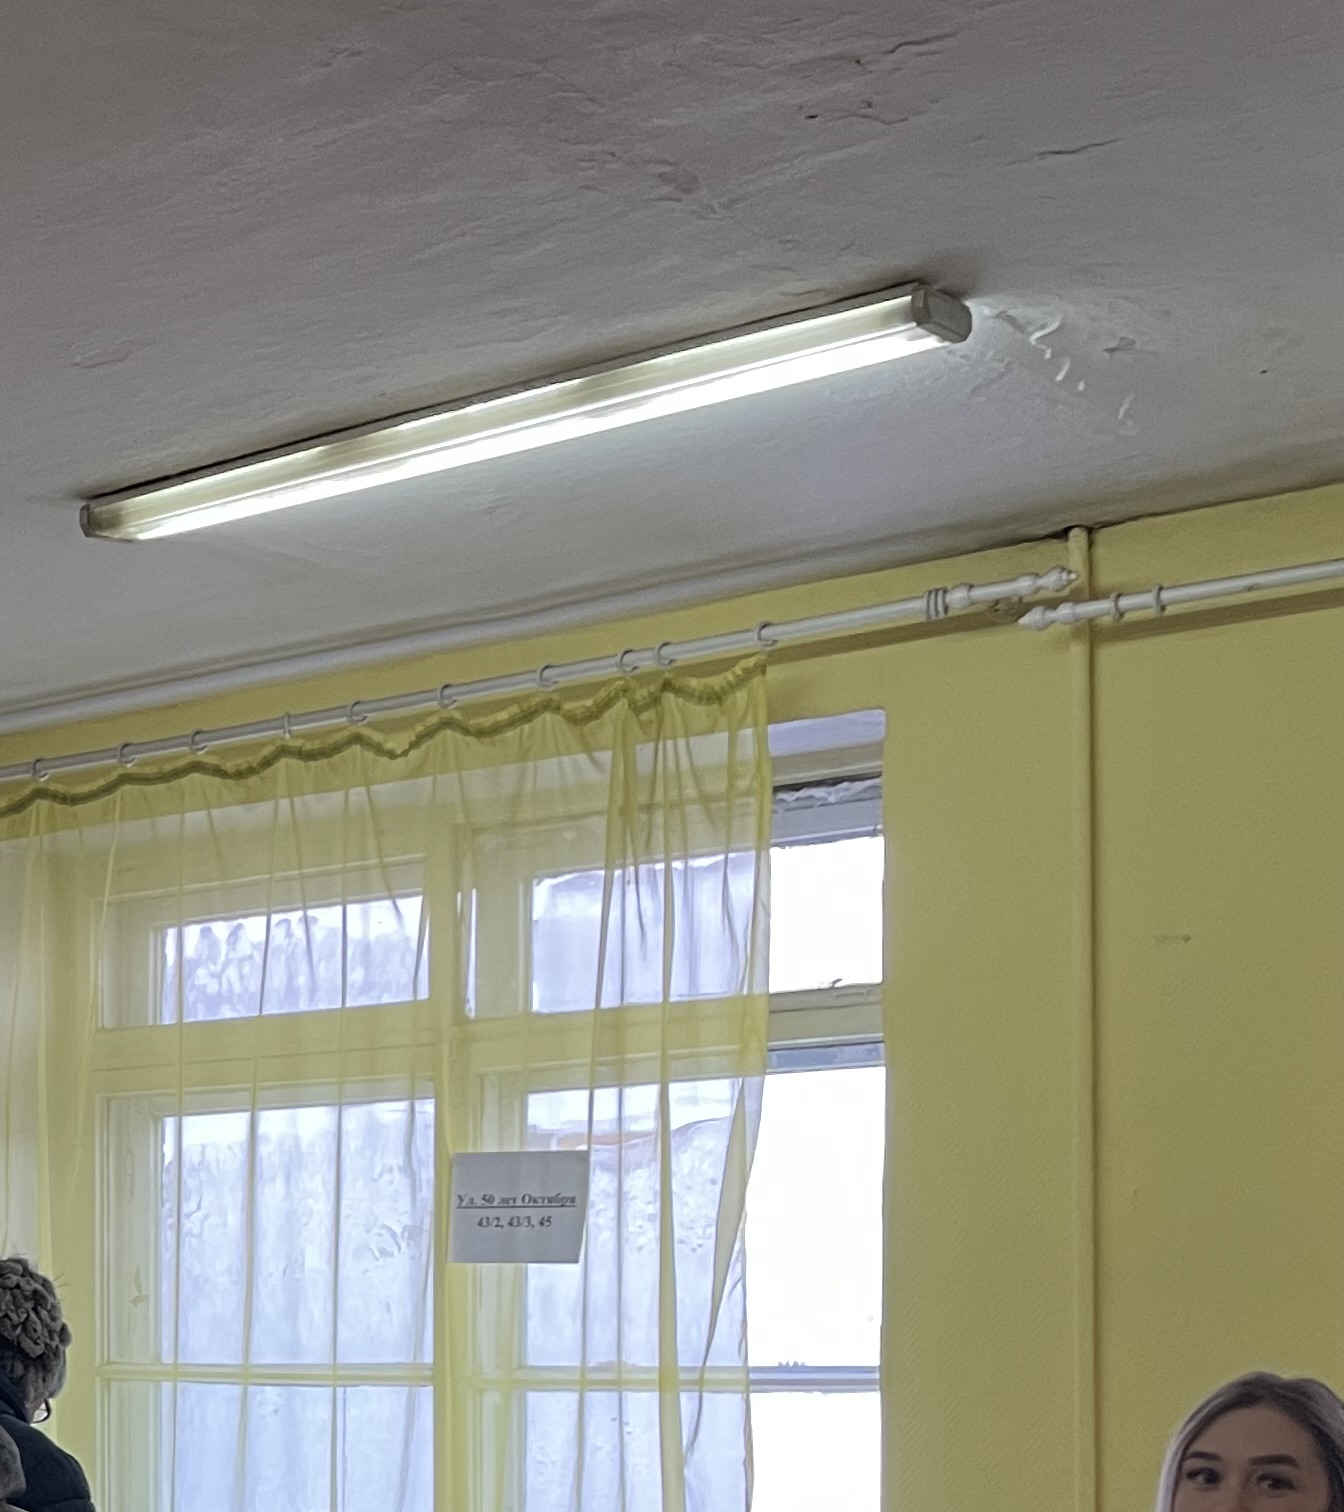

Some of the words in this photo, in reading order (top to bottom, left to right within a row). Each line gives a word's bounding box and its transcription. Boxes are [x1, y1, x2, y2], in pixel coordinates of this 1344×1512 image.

[481, 1193, 495, 1206] 50
[497, 1196, 517, 1206] лет
[521, 1192, 576, 1209] Октября
[538, 1215, 552, 1228] 45
